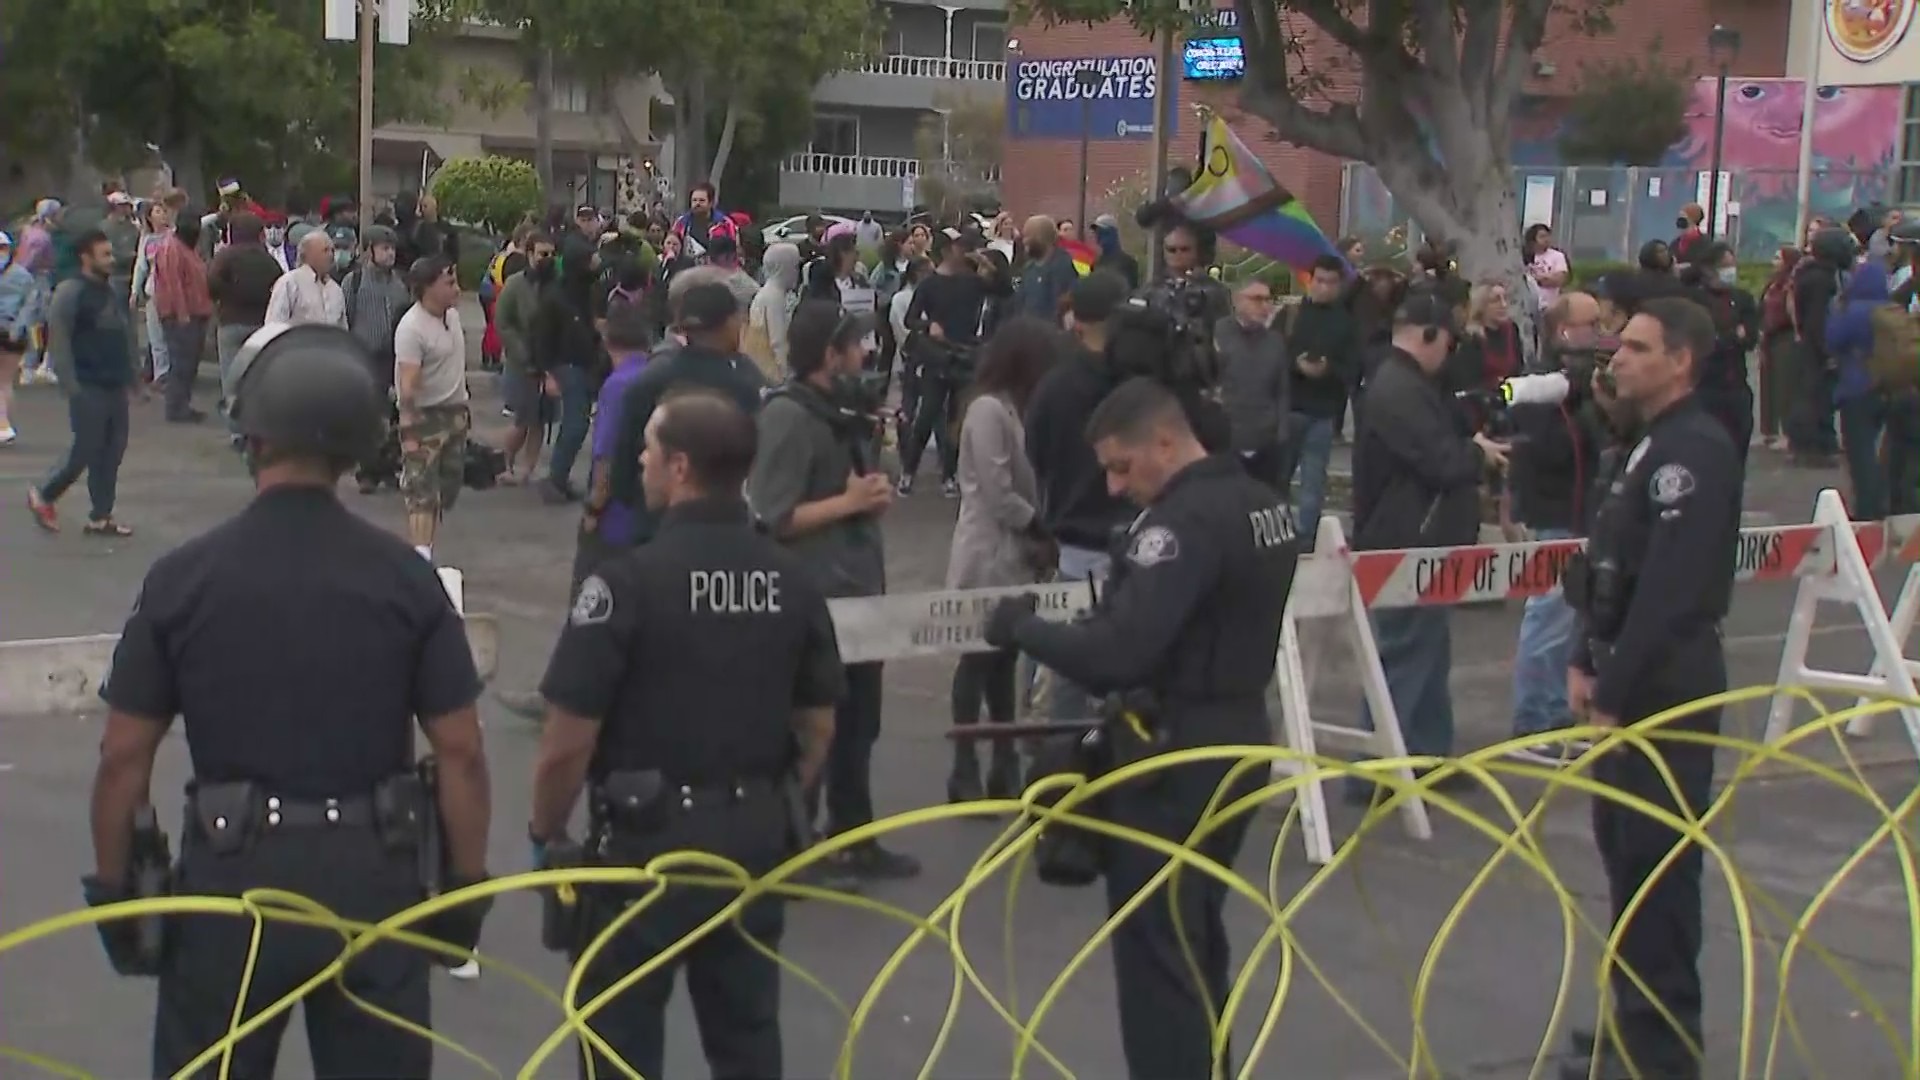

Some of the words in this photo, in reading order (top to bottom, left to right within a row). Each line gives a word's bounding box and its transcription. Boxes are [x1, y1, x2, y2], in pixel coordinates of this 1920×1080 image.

[1018, 58, 1157, 78] CONGRATULATION
[1018, 75, 1156, 100] GRADUATES
[1416, 556, 1463, 596] CITY
[1474, 553, 1499, 592] OF
[1734, 532, 1783, 571] ORKS
[689, 570, 782, 613] POLICE
